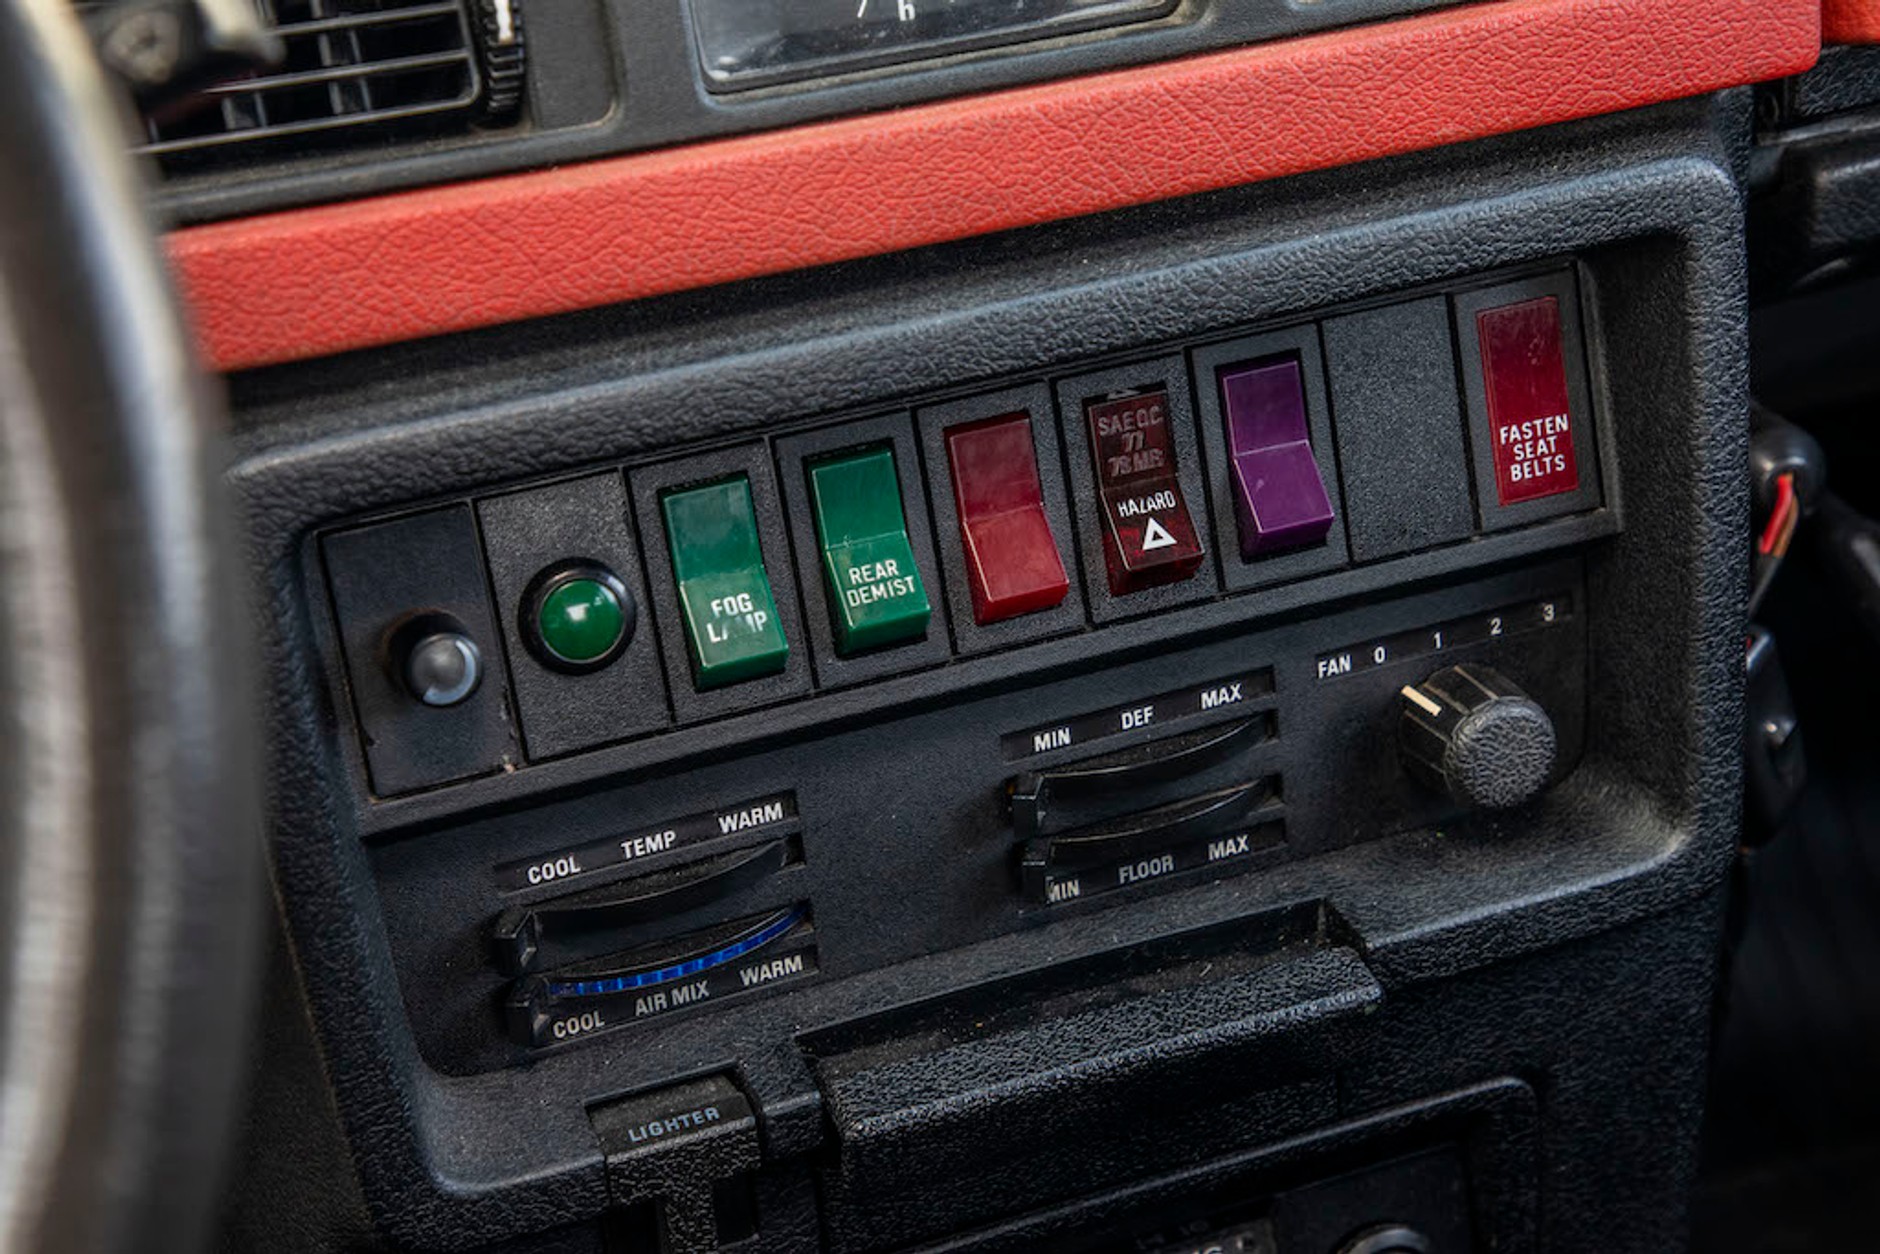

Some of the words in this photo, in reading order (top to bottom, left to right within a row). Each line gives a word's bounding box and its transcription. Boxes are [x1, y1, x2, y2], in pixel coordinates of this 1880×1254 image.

[1500, 413, 1569, 446] FASTEN
[1513, 435, 1557, 461] SEAT
[1510, 454, 1565, 482] BELTS
[1117, 490, 1177, 518] HAZARD
[848, 559, 899, 585] REAR
[711, 592, 754, 618] FOG
[846, 575, 916, 608] DEMIST
[1373, 646, 1387, 664] 0
[1433, 631, 1443, 650] 1
[1490, 617, 1502, 636] 2
[1544, 603, 1555, 622] 3
[1317, 654, 1351, 680] FAN
[1200, 683, 1243, 710] MAX
[1121, 705, 1154, 731] DEF
[1034, 726, 1072, 753] MIN
[718, 802, 784, 834] WARM
[621, 830, 677, 860] TEMP
[1208, 835, 1250, 861] MAX
[527, 855, 581, 885] COOL
[1118, 855, 1175, 885] FLOOR
[1047, 880, 1081, 904] MIN
[739, 955, 804, 987] WARM
[634, 993, 668, 1018] AIR
[672, 980, 711, 1006] MIX
[552, 1010, 606, 1039] COOL
[628, 1107, 720, 1143] LIGHTER
